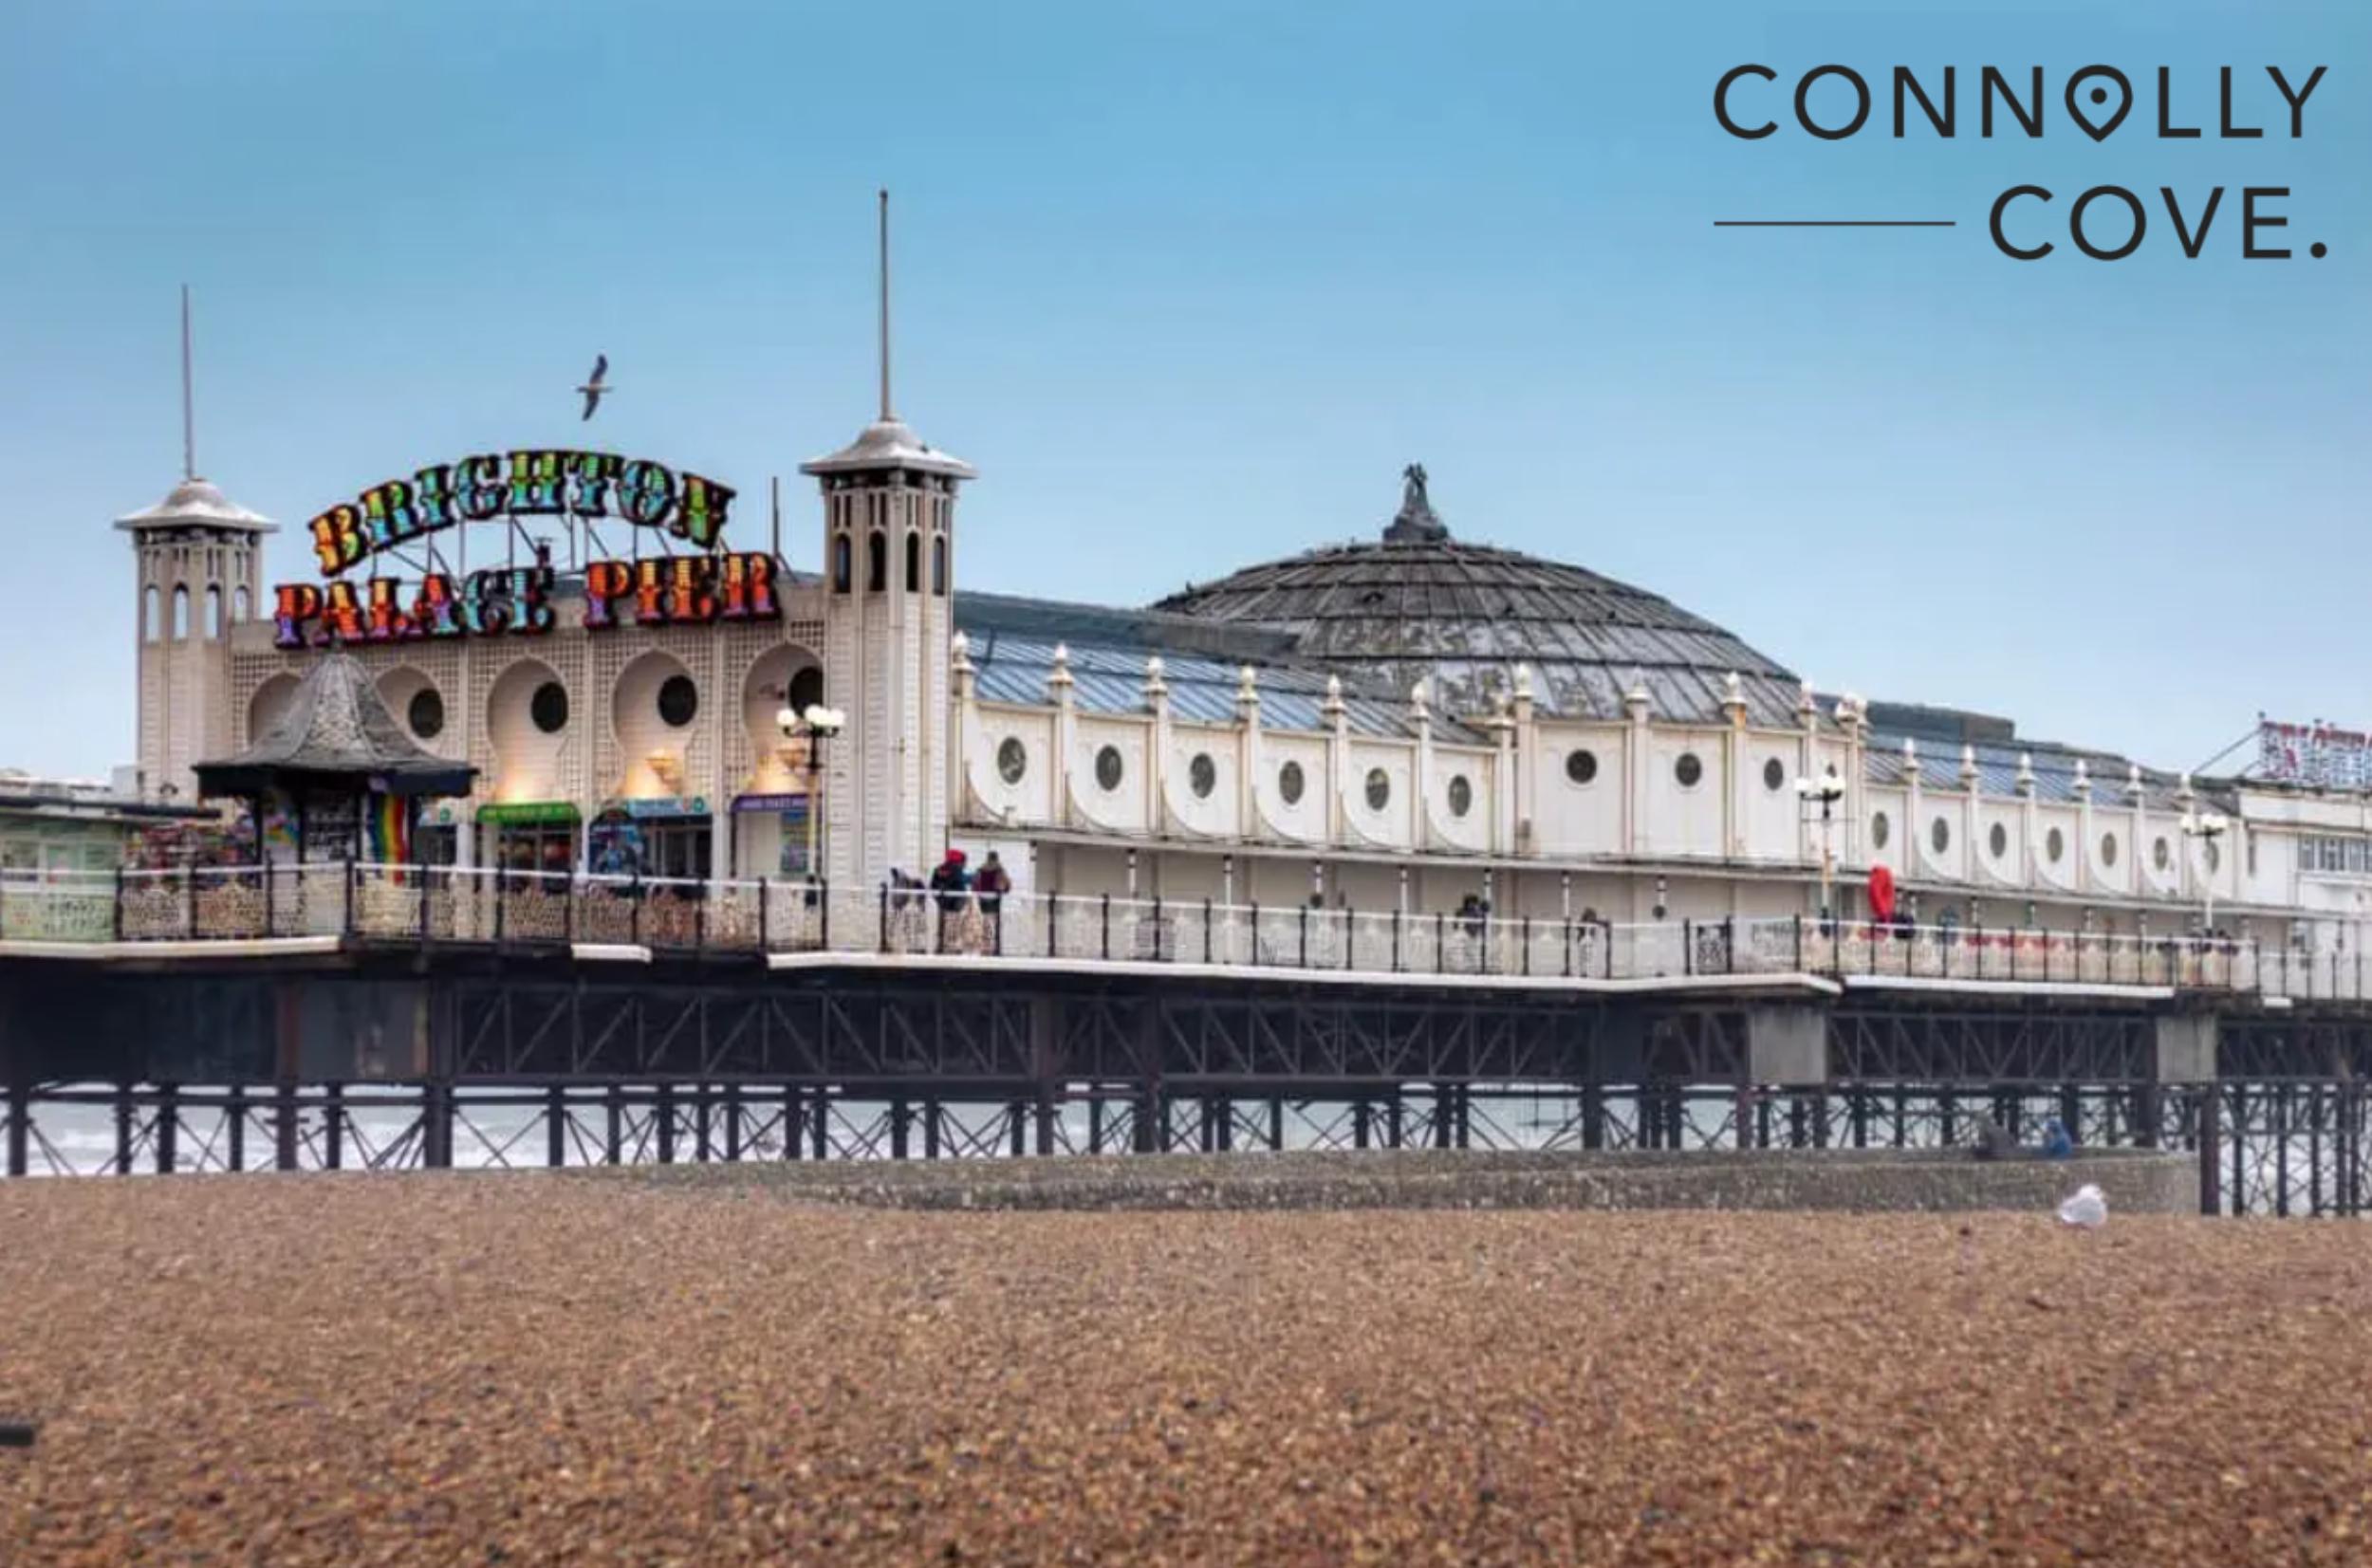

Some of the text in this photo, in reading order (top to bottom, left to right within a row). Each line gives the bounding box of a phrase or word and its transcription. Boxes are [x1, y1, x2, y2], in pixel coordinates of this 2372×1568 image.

[308, 450, 737, 576] BRIGHTON
[273, 551, 780, 650] PALACE PIER
